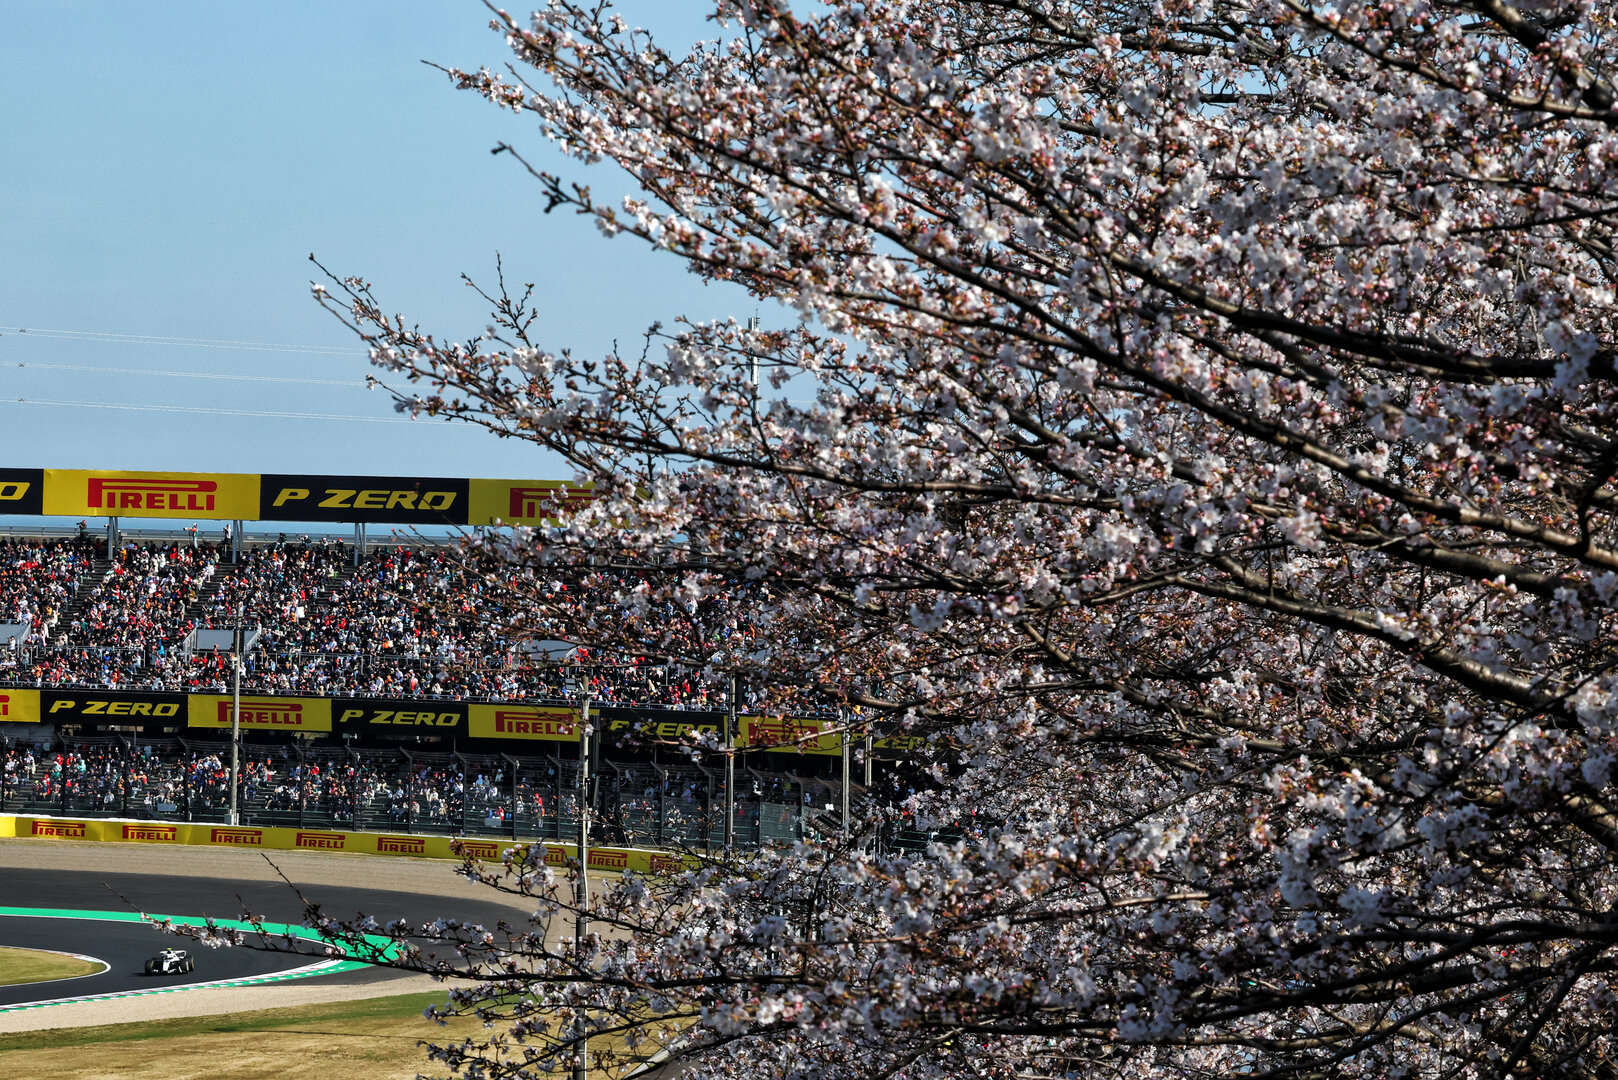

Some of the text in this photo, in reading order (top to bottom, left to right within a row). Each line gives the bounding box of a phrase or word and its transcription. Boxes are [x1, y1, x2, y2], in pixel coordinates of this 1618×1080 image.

[88, 478, 218, 511] PIRELLI
[272, 488, 457, 511] P ZERO
[49, 700, 180, 717] P ZERO
[340, 709, 461, 727] P ZERO
[31, 820, 86, 838] PIRELLI
[122, 825, 177, 841] PIRELLI
[210, 828, 263, 845] PIRELLI
[295, 832, 346, 849] PIRELLI
[377, 837, 425, 854] PIRELLI
[587, 850, 628, 867] PIRELLI
